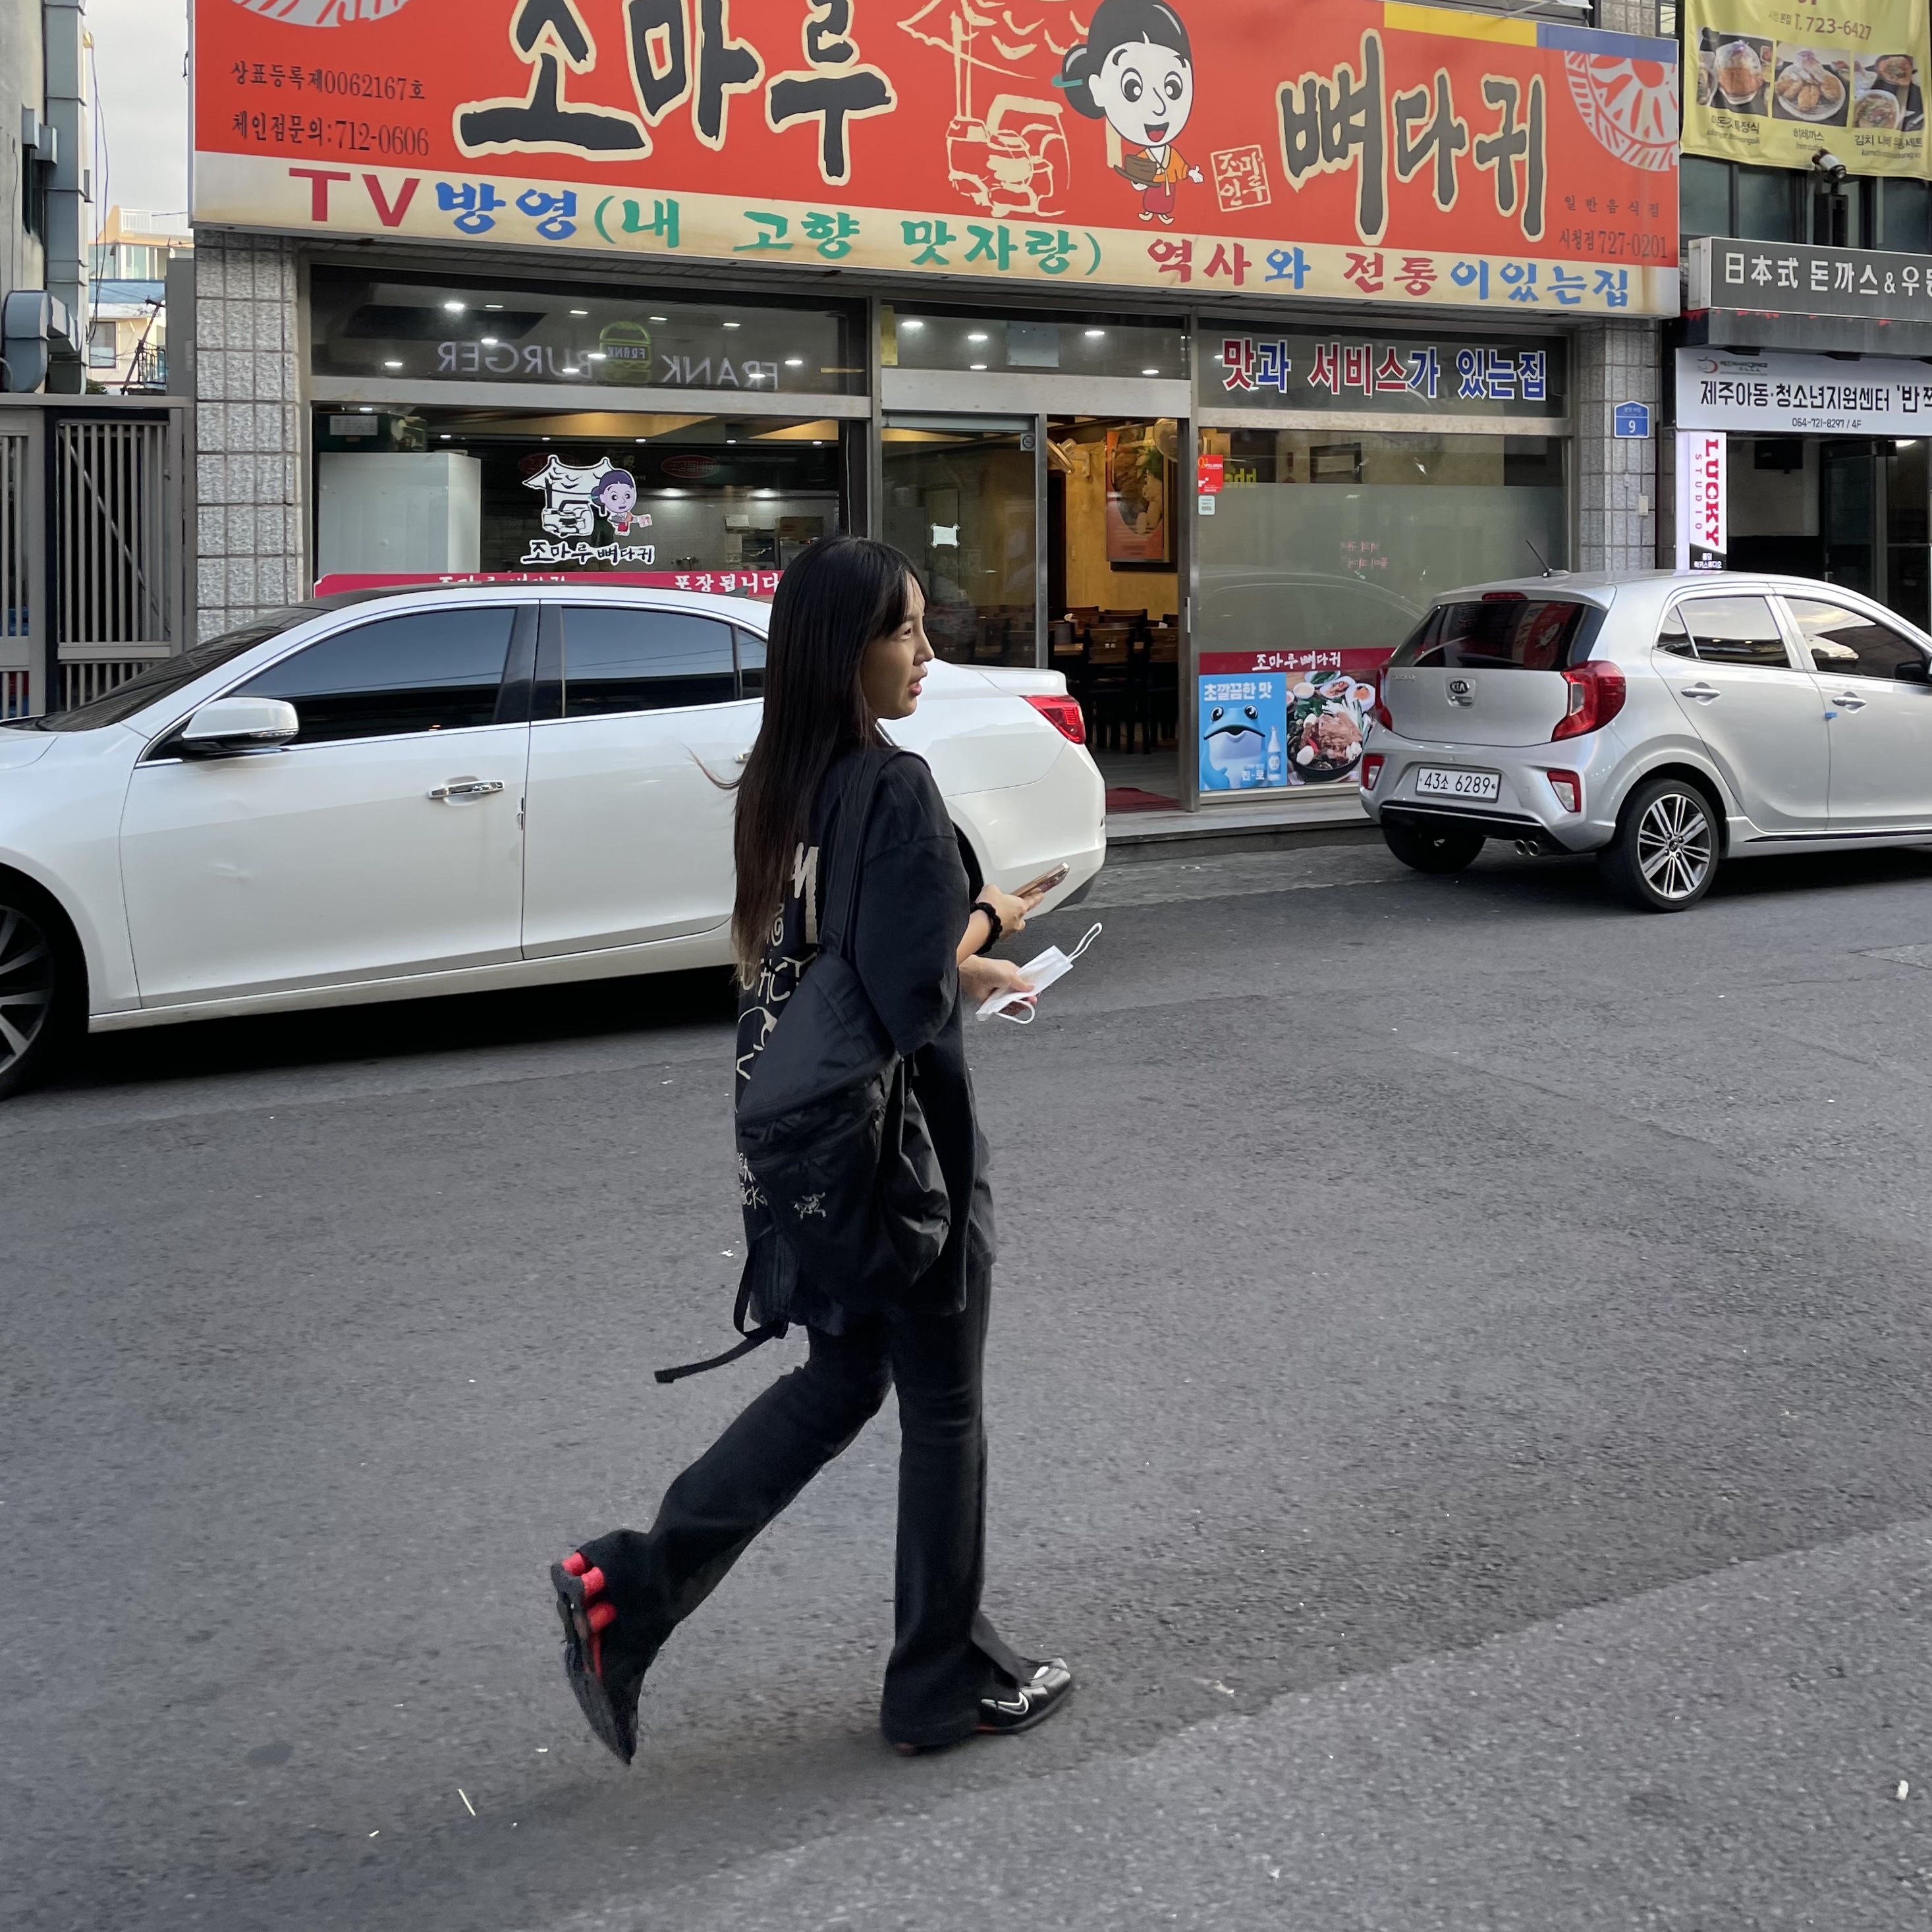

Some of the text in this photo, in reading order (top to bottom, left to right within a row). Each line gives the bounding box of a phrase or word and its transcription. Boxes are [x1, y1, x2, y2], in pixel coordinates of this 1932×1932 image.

[1806, 16, 1871, 40] 723-6427
[231, 61, 425, 100] 상표등록제0062167호
[1276, 28, 1546, 245] 뼈다귀
[1855, 134, 1874, 146] 김치
[289, 167, 420, 227] TV
[733, 211, 860, 260] 고향
[900, 219, 1102, 276] 맛자랑)
[1599, 231, 1668, 259] 727-0201
[1725, 252, 1800, 289] 日本式
[1222, 337, 1547, 401] 맛과 서비스가 있는집
[1628, 420, 1636, 433] 9
[1792, 417, 1845, 428] 064-721-8297
[1852, 419, 1862, 429] 4F
[1706, 439, 1719, 546] LUCKY
[522, 541, 652, 563] 조마루 뼈다귀
[1252, 649, 1341, 671] 조마루 뼈다귀
[1203, 681, 1273, 702] 초깔끔한 맛
[1451, 682, 1466, 692] KIA
[1424, 772, 1491, 794] 43소 6289
